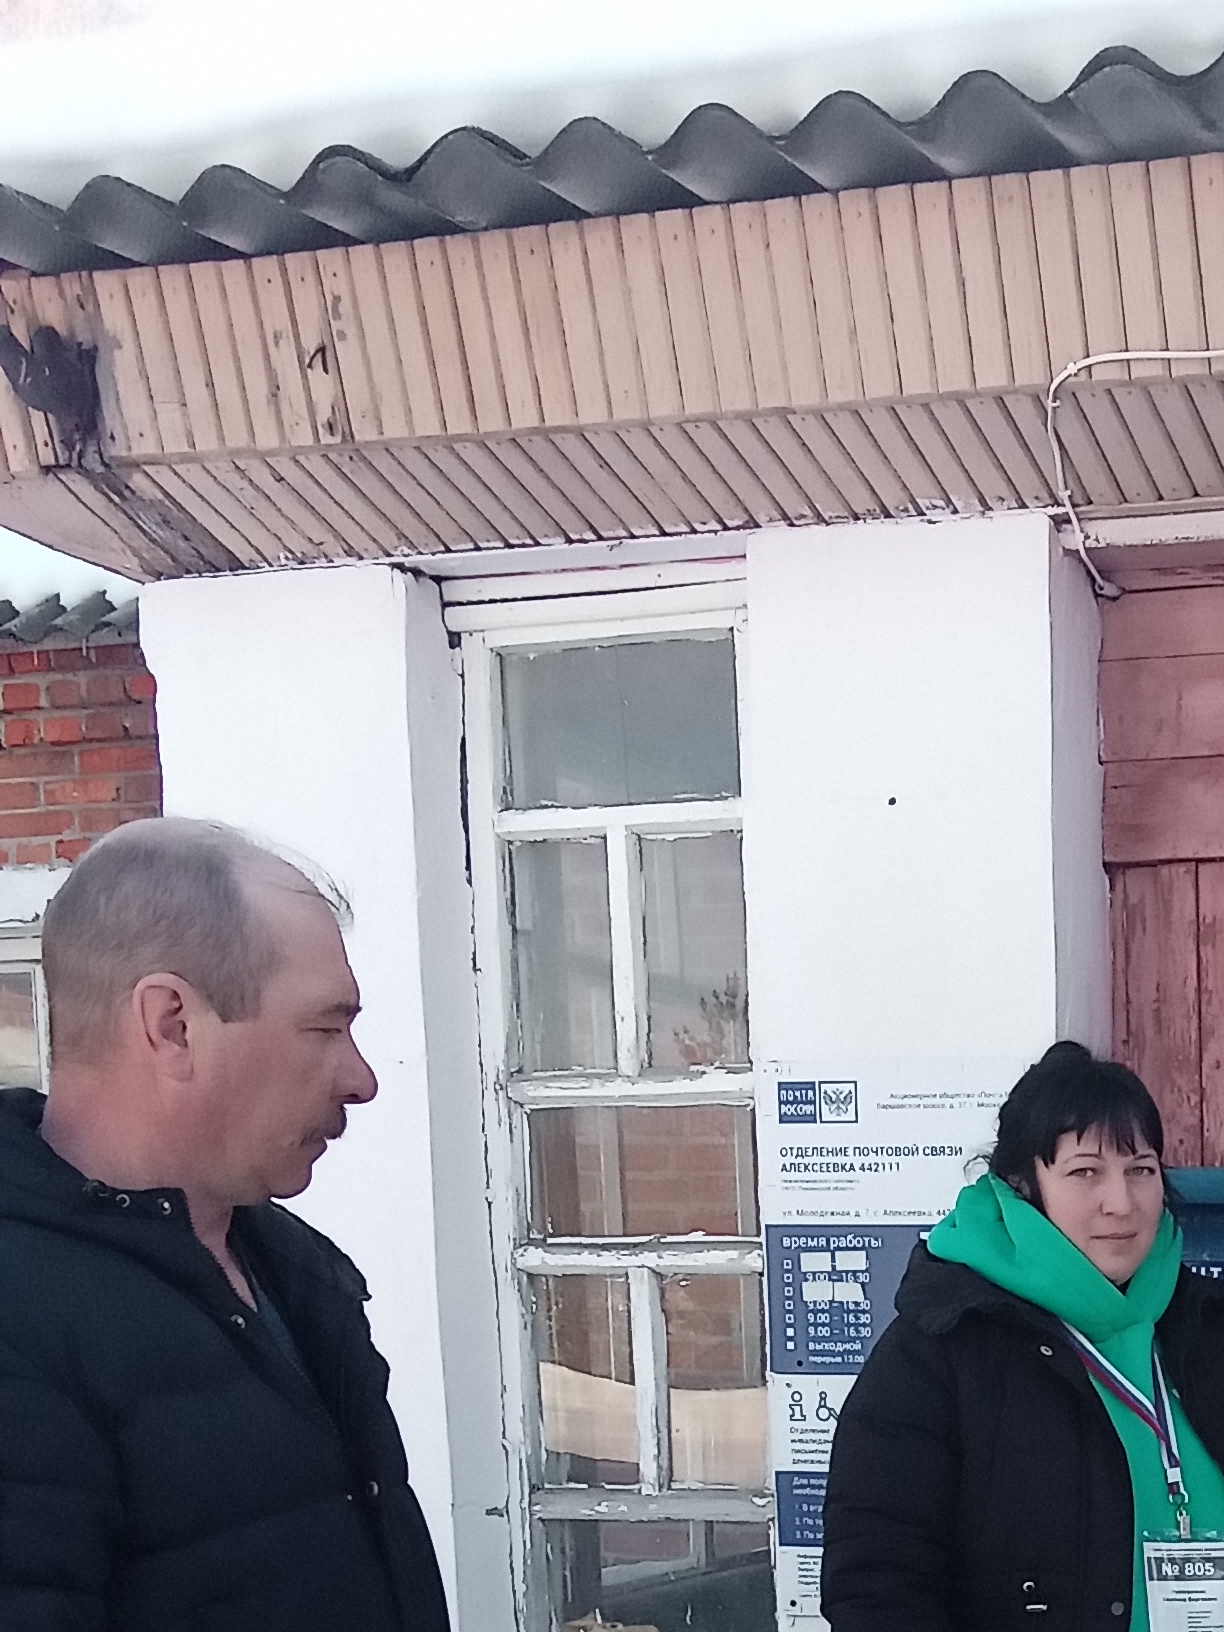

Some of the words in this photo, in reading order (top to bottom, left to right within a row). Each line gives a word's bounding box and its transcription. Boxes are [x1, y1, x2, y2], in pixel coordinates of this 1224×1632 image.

[780, 1090, 814, 1101] ПОЧТА
[780, 1104, 814, 1116] РОССИИ
[779, 1146, 849, 1159] ОТДЕЛЕНИЕ
[853, 1144, 919, 1157] ПОЧТОВОЙ
[922, 1146, 963, 1157] СВЯЗИ
[780, 1162, 856, 1173] АЛЕКСЕЕВКА
[858, 1162, 900, 1173] 442111
[782, 1236, 827, 1249] время
[830, 1233, 882, 1249] работы
[843, 1313, 871, 1323] 16.30
[844, 1327, 871, 1337] 16.30
[808, 1340, 862, 1352] выходной
[1162, 1563, 1180, 1575] №
[1185, 1563, 1214, 1575] 805
